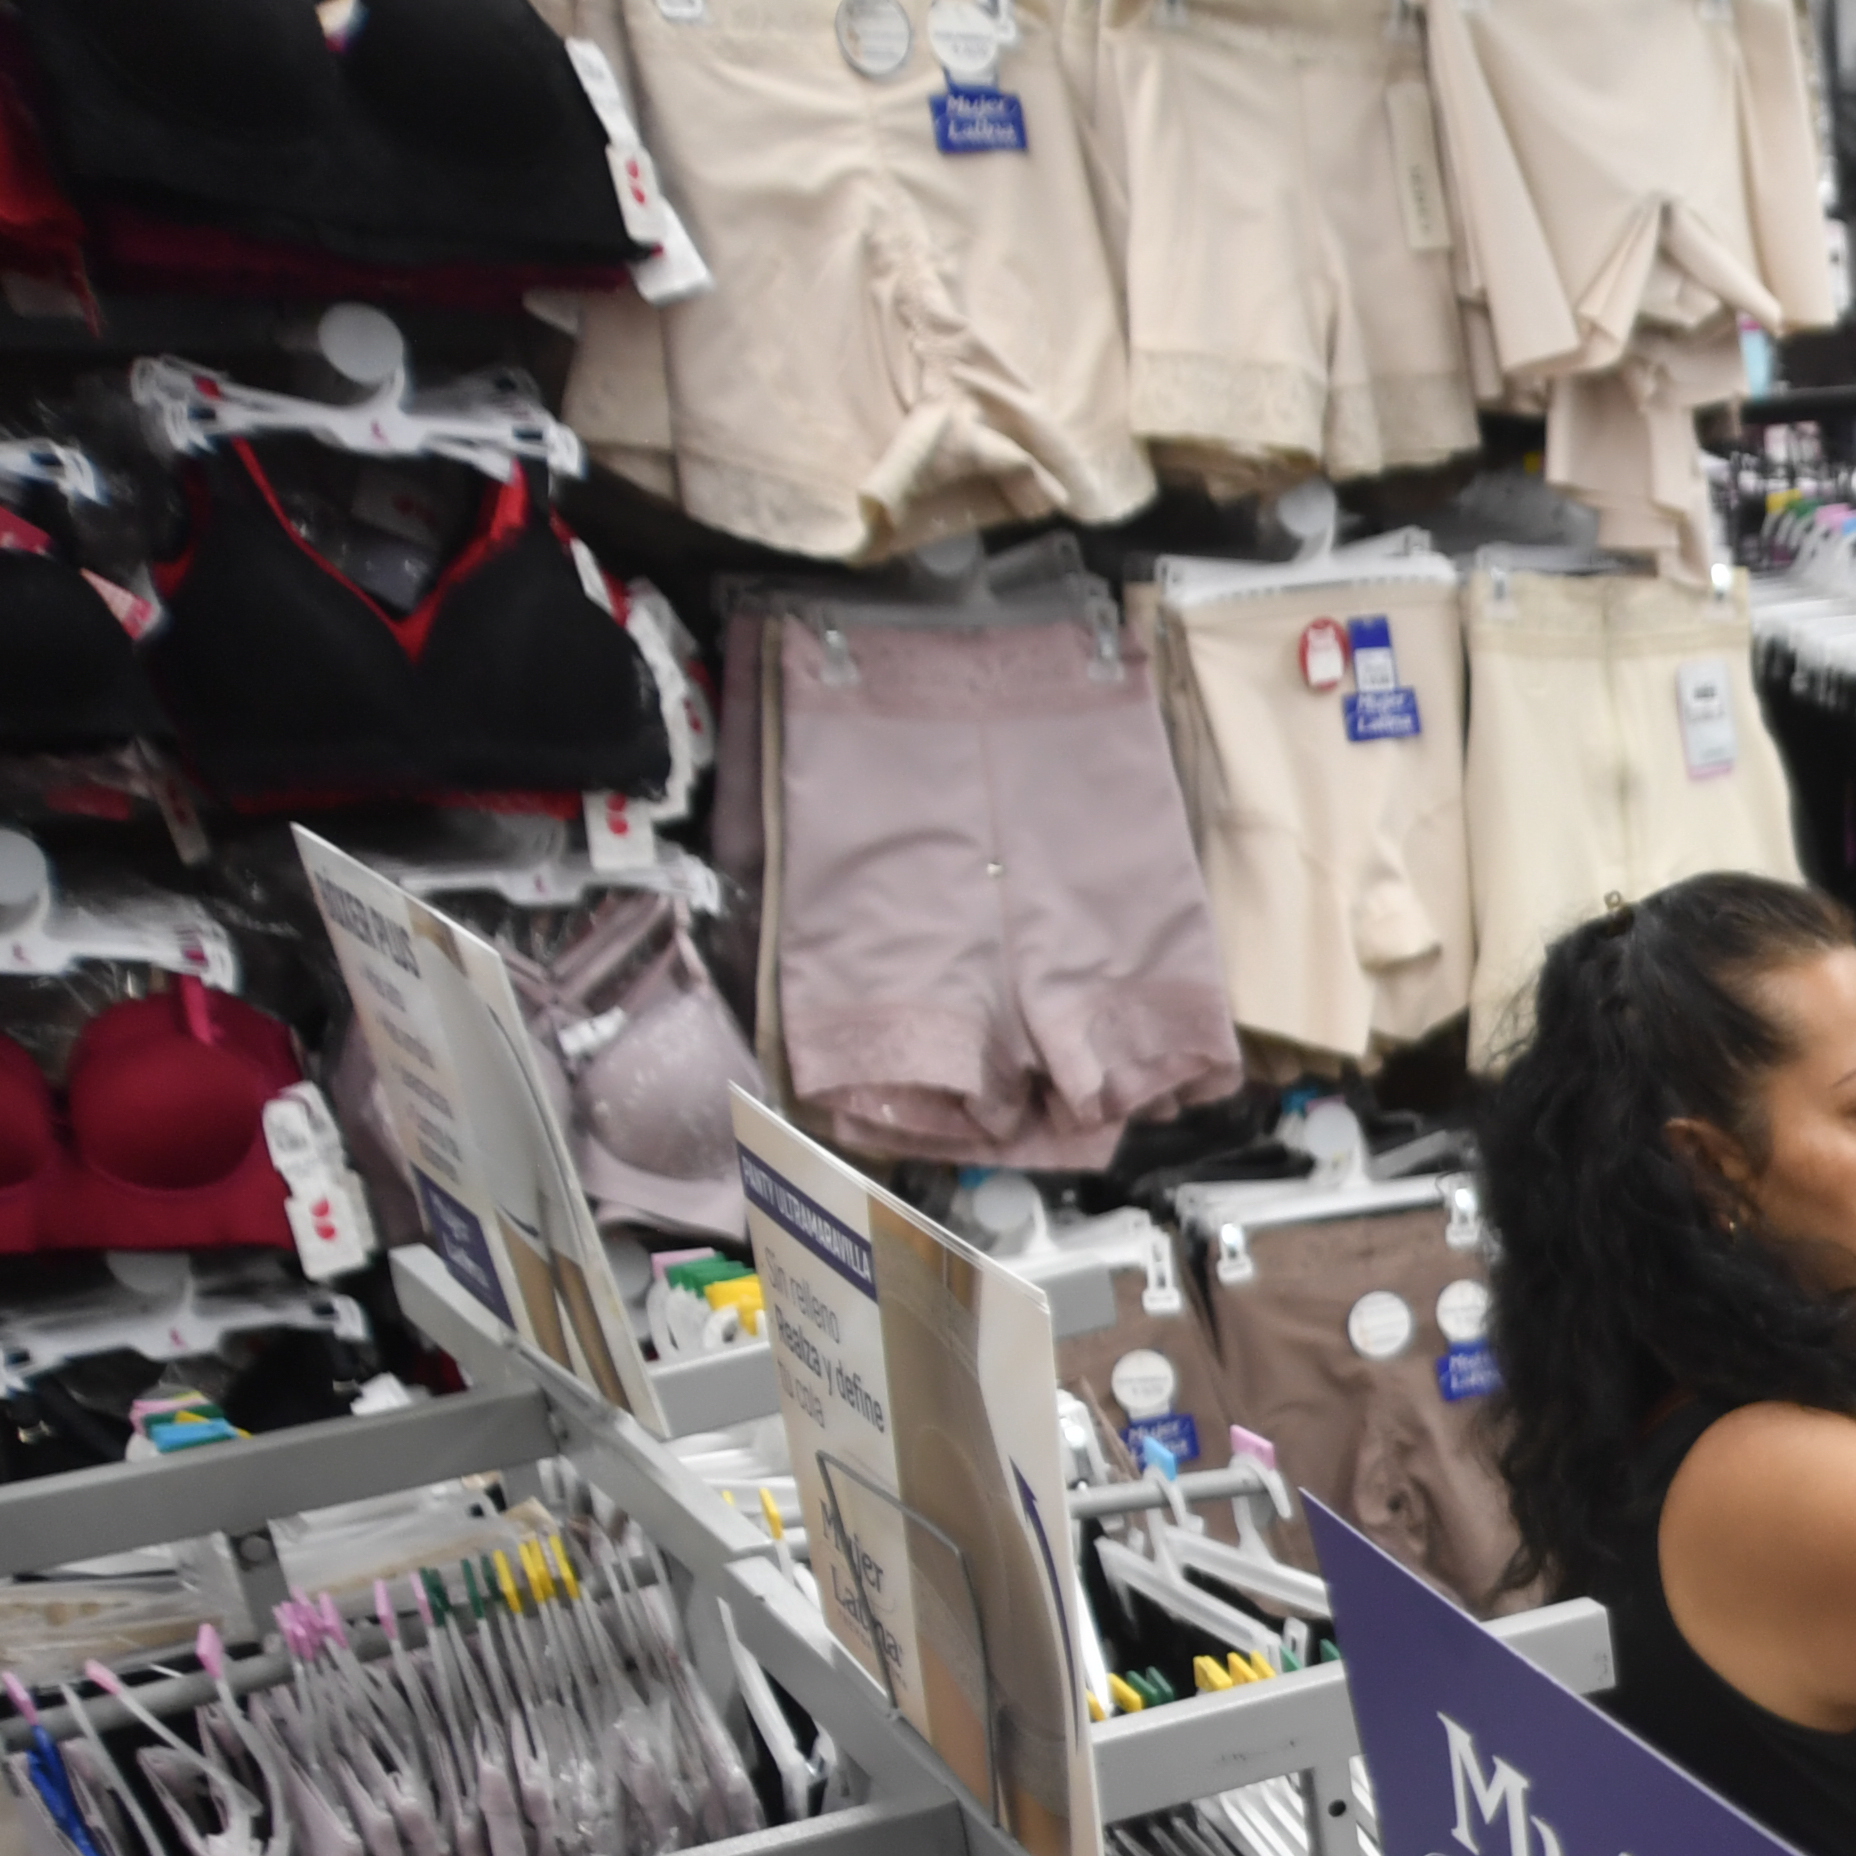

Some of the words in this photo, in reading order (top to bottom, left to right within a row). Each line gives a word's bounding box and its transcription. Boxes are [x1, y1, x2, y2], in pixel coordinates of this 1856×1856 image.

[764, 1246, 788, 1297] Sin
[789, 1275, 841, 1344] relleno
[774, 1303, 822, 1378] Realiza
[823, 1353, 834, 1397] y
[836, 1358, 885, 1433] define
[795, 1372, 826, 1429] cola
